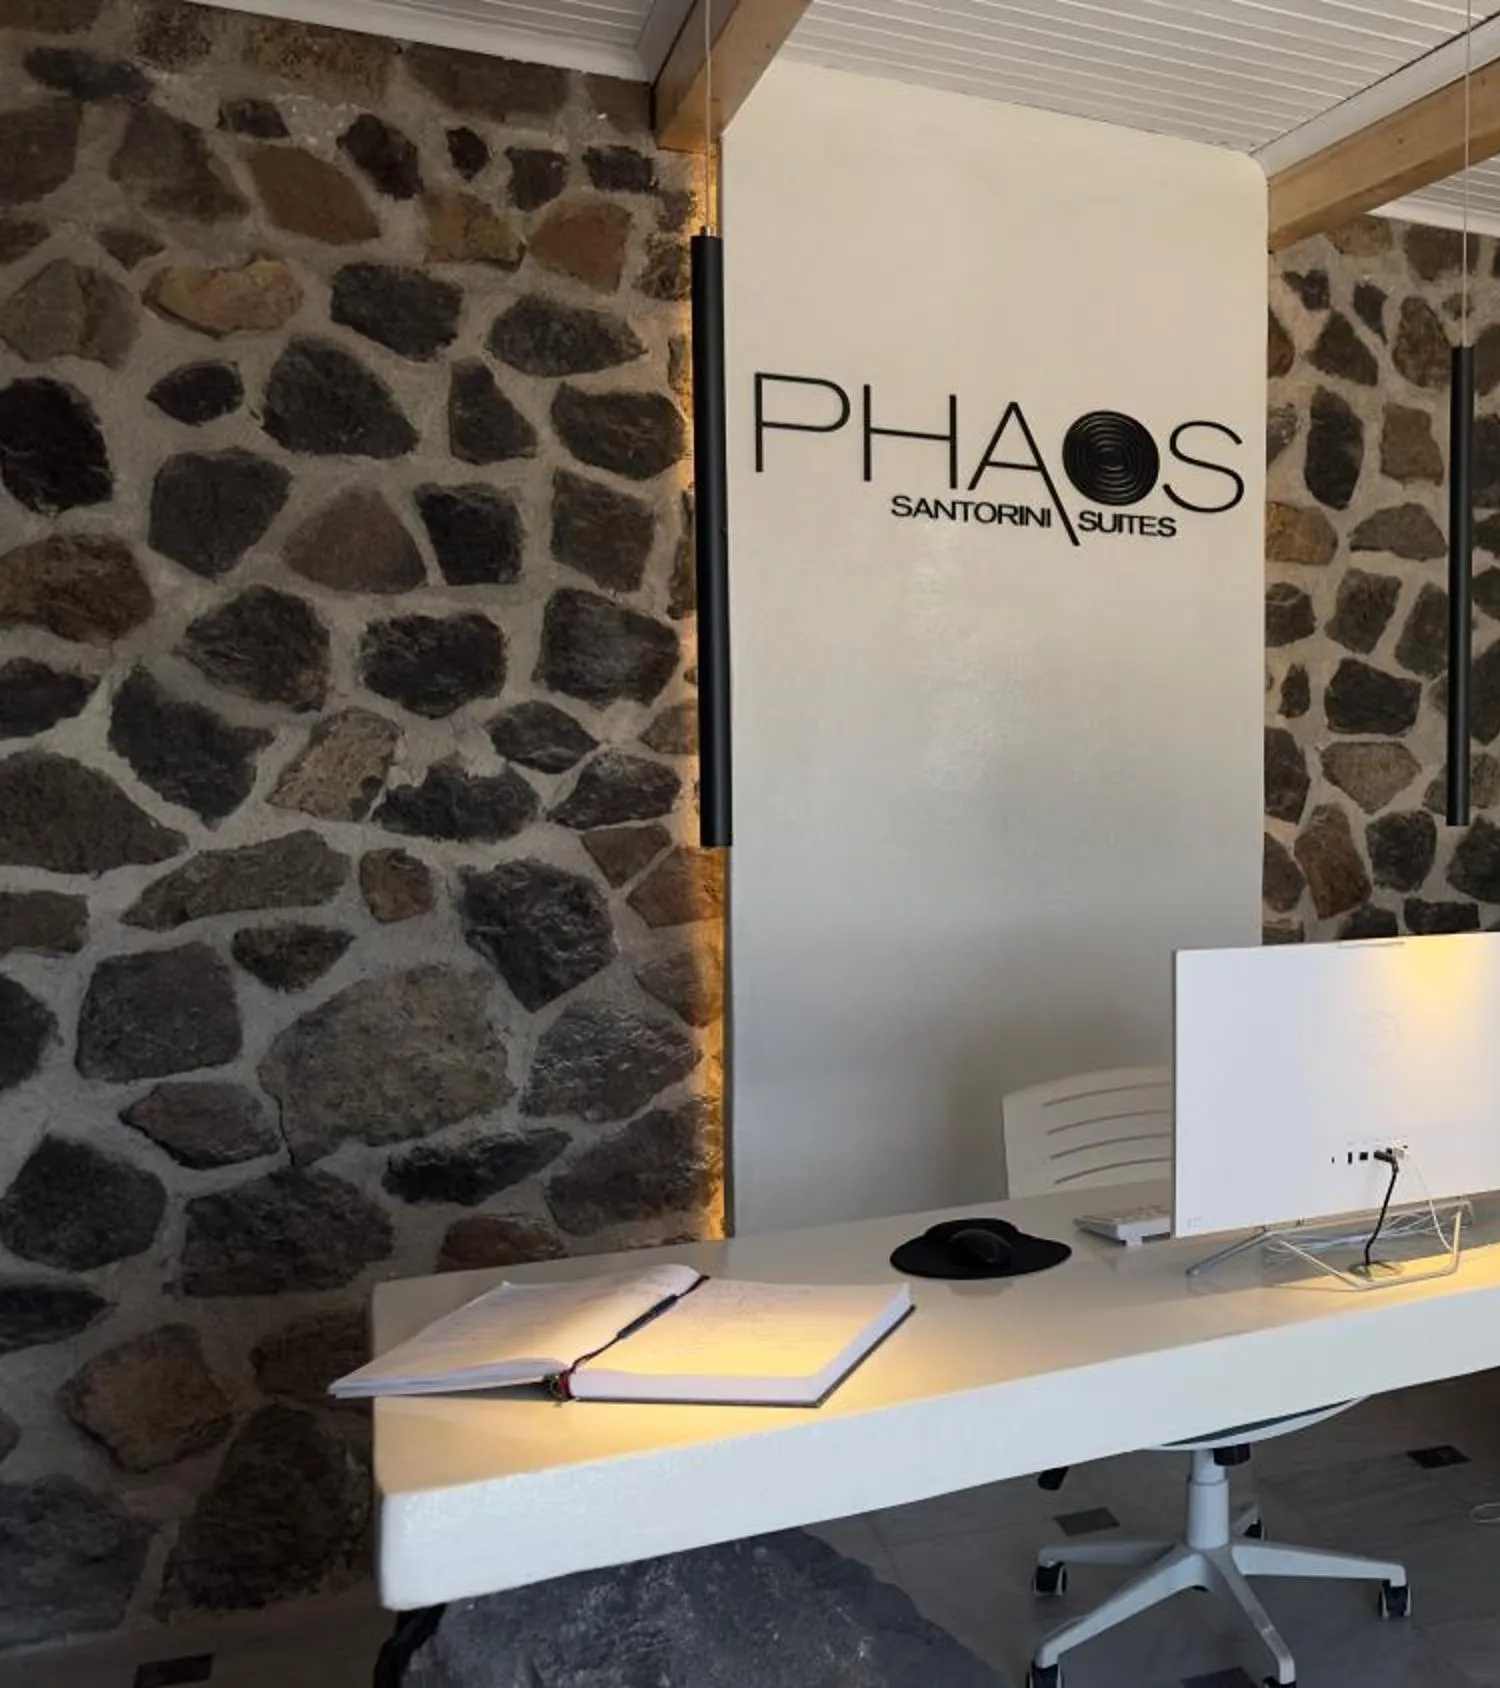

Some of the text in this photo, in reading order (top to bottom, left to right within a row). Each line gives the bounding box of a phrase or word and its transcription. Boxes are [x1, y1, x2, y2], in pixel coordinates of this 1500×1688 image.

[753, 371, 1245, 547] PHAOS
[890, 494, 1177, 538] SANTORINI SUITES
